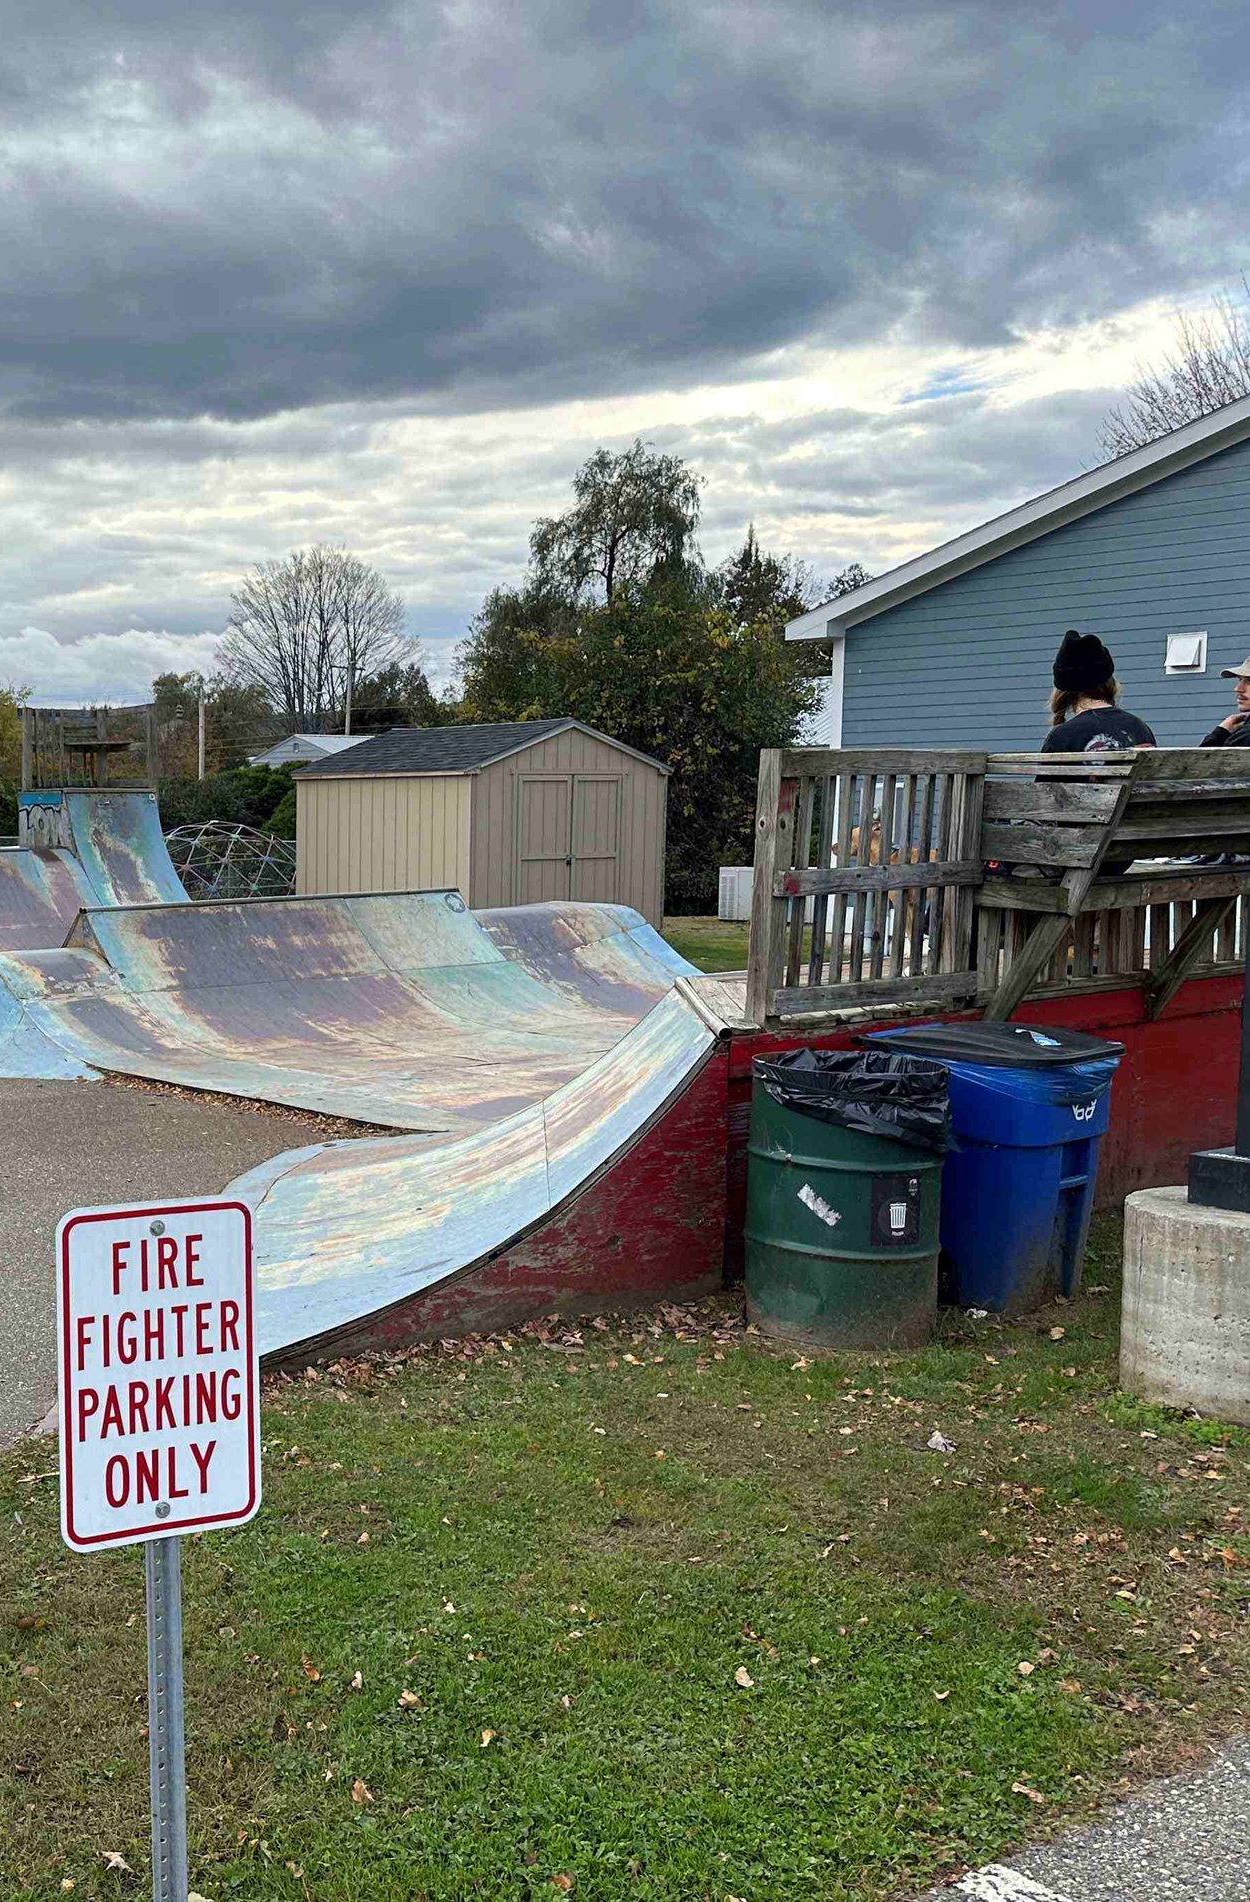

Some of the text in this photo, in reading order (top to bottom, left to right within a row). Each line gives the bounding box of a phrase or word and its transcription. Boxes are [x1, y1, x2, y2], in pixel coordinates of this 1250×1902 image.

[112, 1233, 205, 1295] FIRE
[77, 1299, 240, 1371] FIGHTER
[78, 1368, 242, 1443] PARKING
[105, 1440, 218, 1508] ONLY
